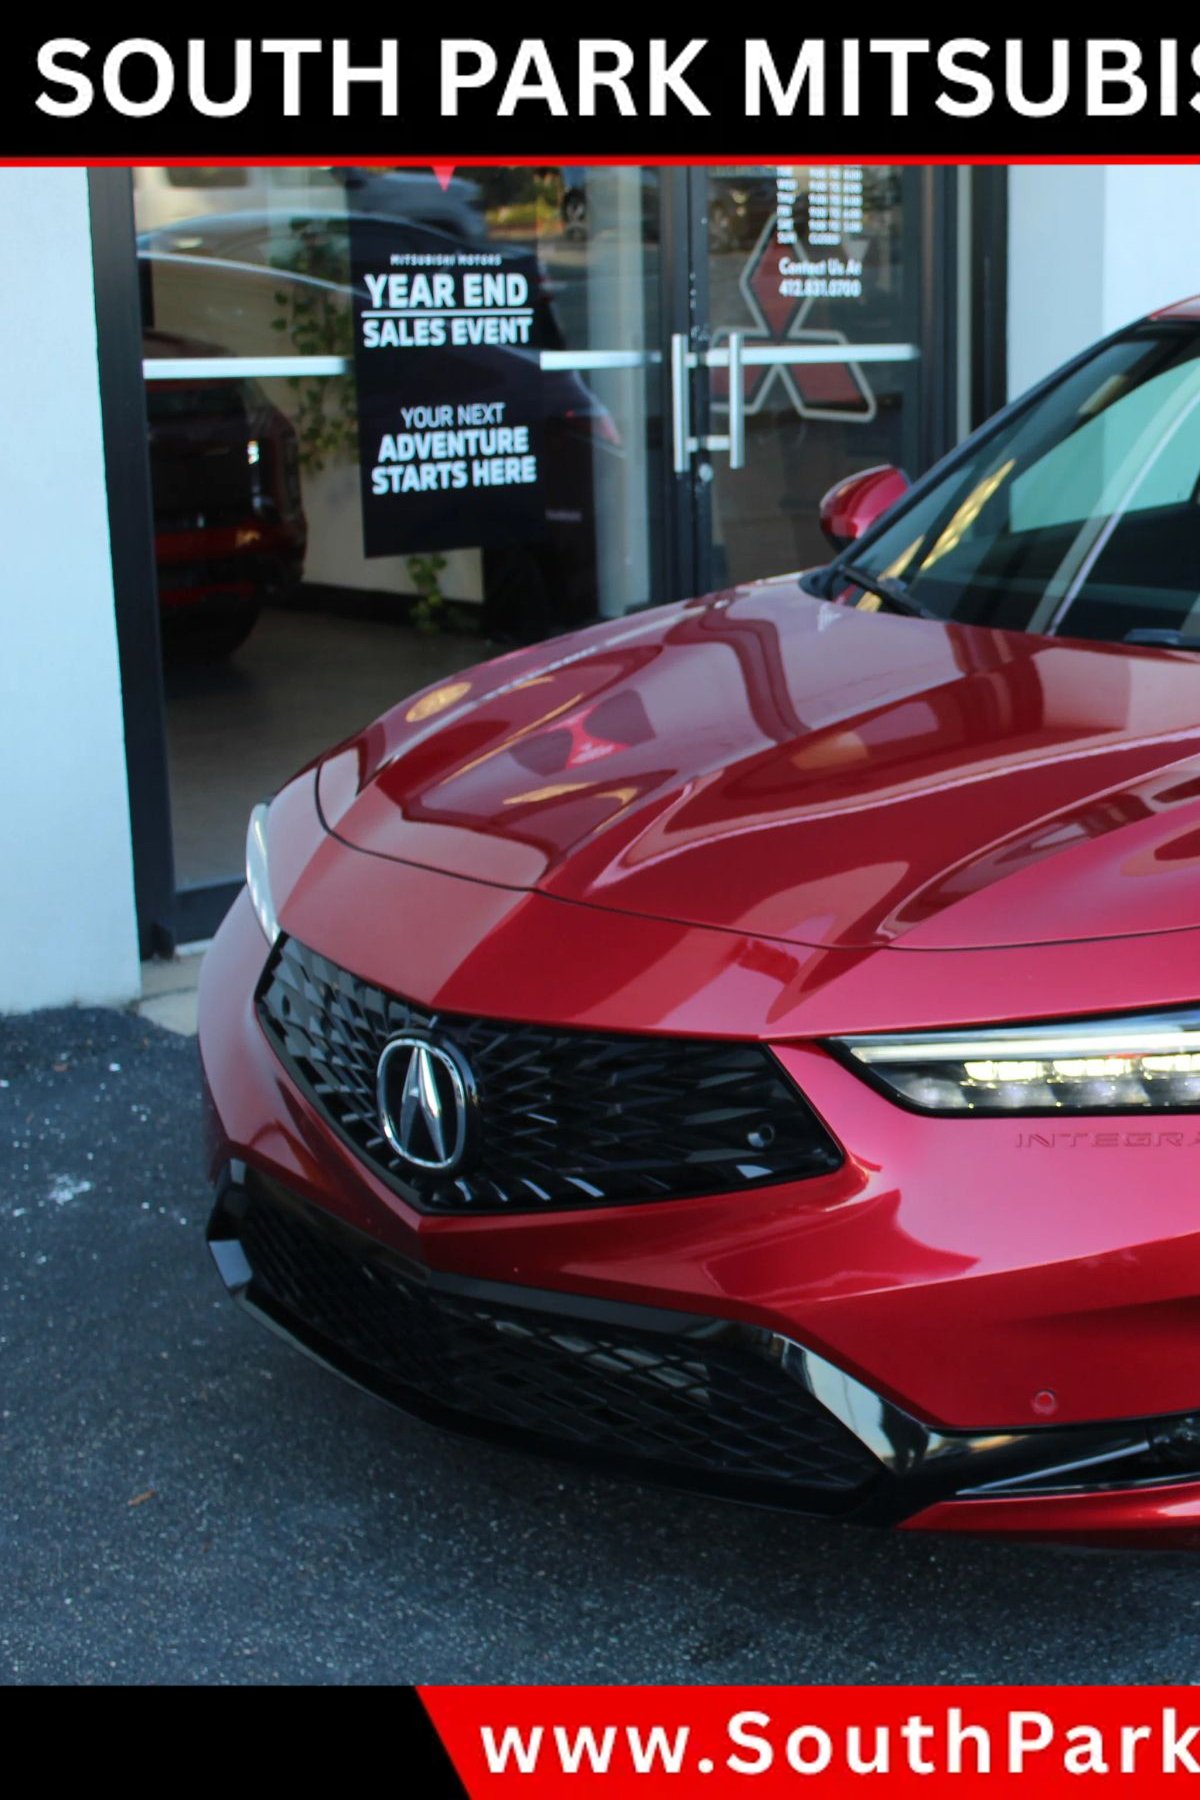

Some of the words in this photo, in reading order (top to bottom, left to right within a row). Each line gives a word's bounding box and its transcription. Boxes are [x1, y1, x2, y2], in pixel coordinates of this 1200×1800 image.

[365, 275, 455, 309] YEAR
[464, 273, 528, 307] END
[362, 318, 446, 348] SALES
[452, 317, 532, 345] EVENT
[401, 405, 454, 428] YOUR
[457, 403, 504, 427] NEXT
[379, 427, 529, 462] ADVENTURE
[372, 461, 467, 495] STARTS
[473, 457, 536, 487] HERE
